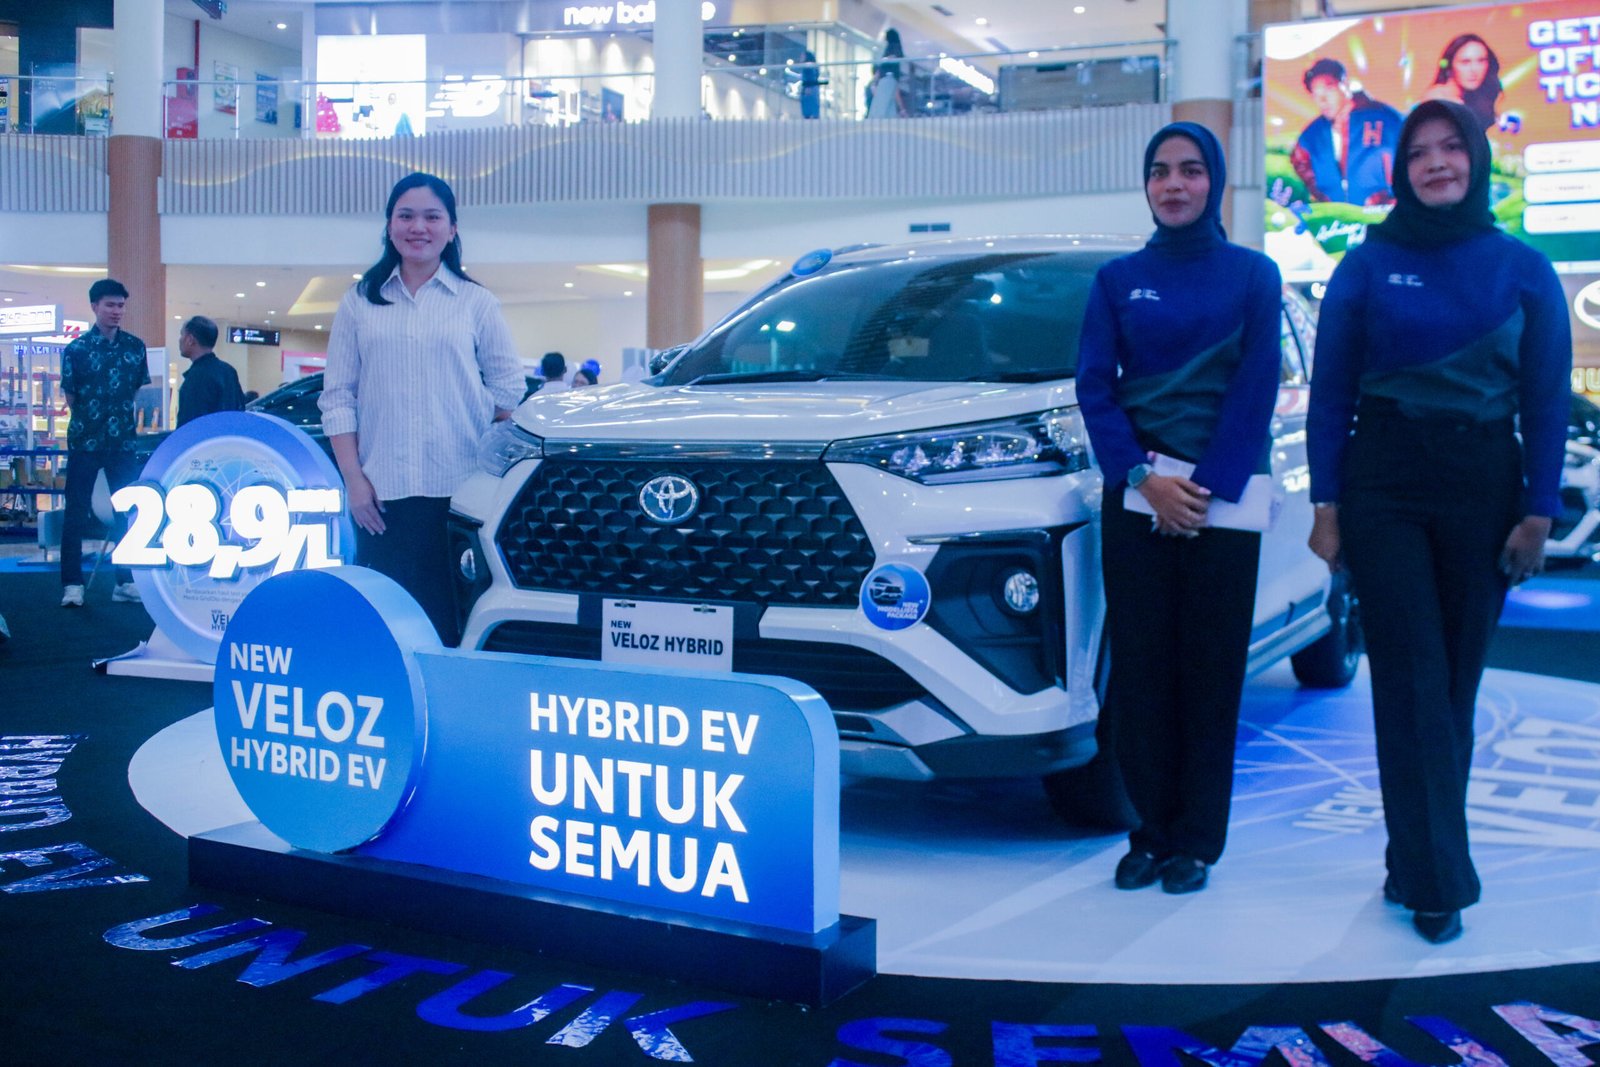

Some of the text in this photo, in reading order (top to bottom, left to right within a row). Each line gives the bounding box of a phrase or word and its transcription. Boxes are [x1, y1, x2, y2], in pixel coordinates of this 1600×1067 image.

[564, 6, 614, 25] new
[1528, 16, 1600, 46] GET
[111, 484, 289, 578] 28,9
[611, 620, 631, 629] NEW
[611, 631, 723, 655] VELOZ HYBRID
[230, 642, 293, 675] NEW
[231, 680, 385, 748] VELOZ
[530, 692, 760, 755] HYBRID EV
[231, 736, 386, 790] HYBRID EV
[530, 749, 748, 833] UNTUK
[528, 815, 750, 904] SEMUA
[102, 903, 741, 1064] UNTUK
